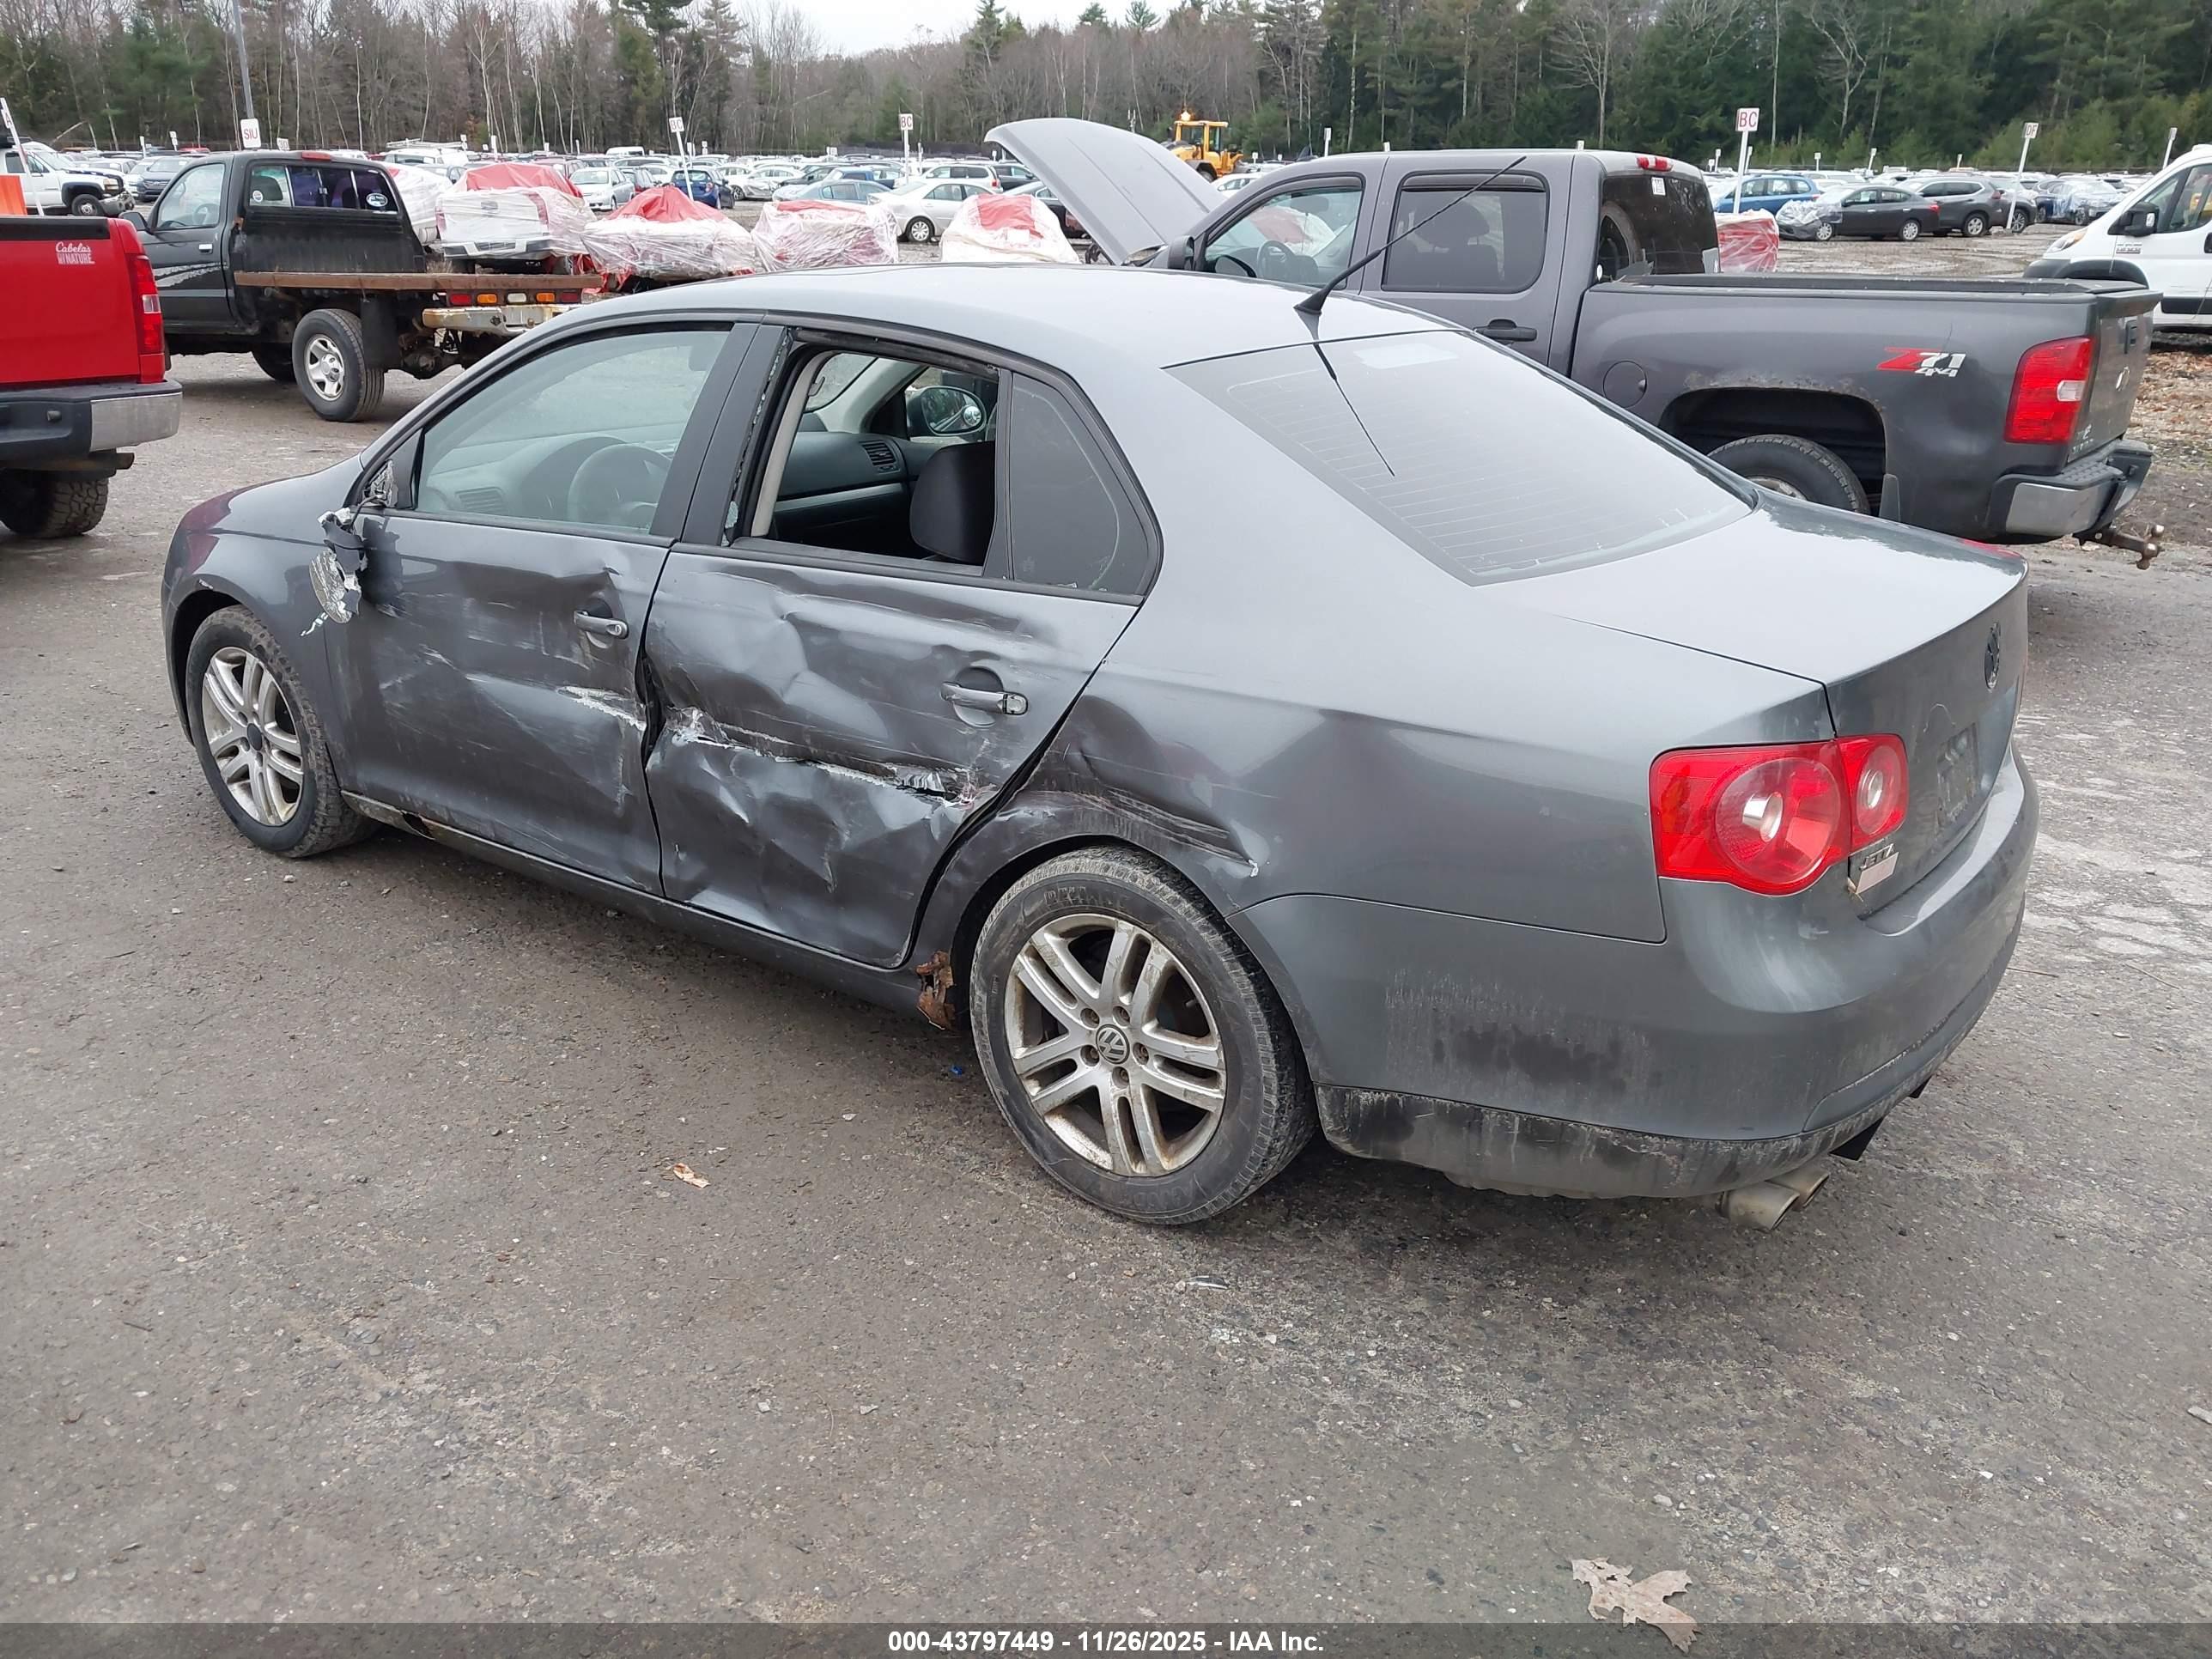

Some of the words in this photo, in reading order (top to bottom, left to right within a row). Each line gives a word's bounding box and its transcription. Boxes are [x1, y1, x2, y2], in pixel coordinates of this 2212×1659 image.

[901, 115, 912, 128] BC
[1739, 111, 1758, 128] BC
[243, 128, 258, 140] SIU
[1875, 346, 1966, 371] Z71
